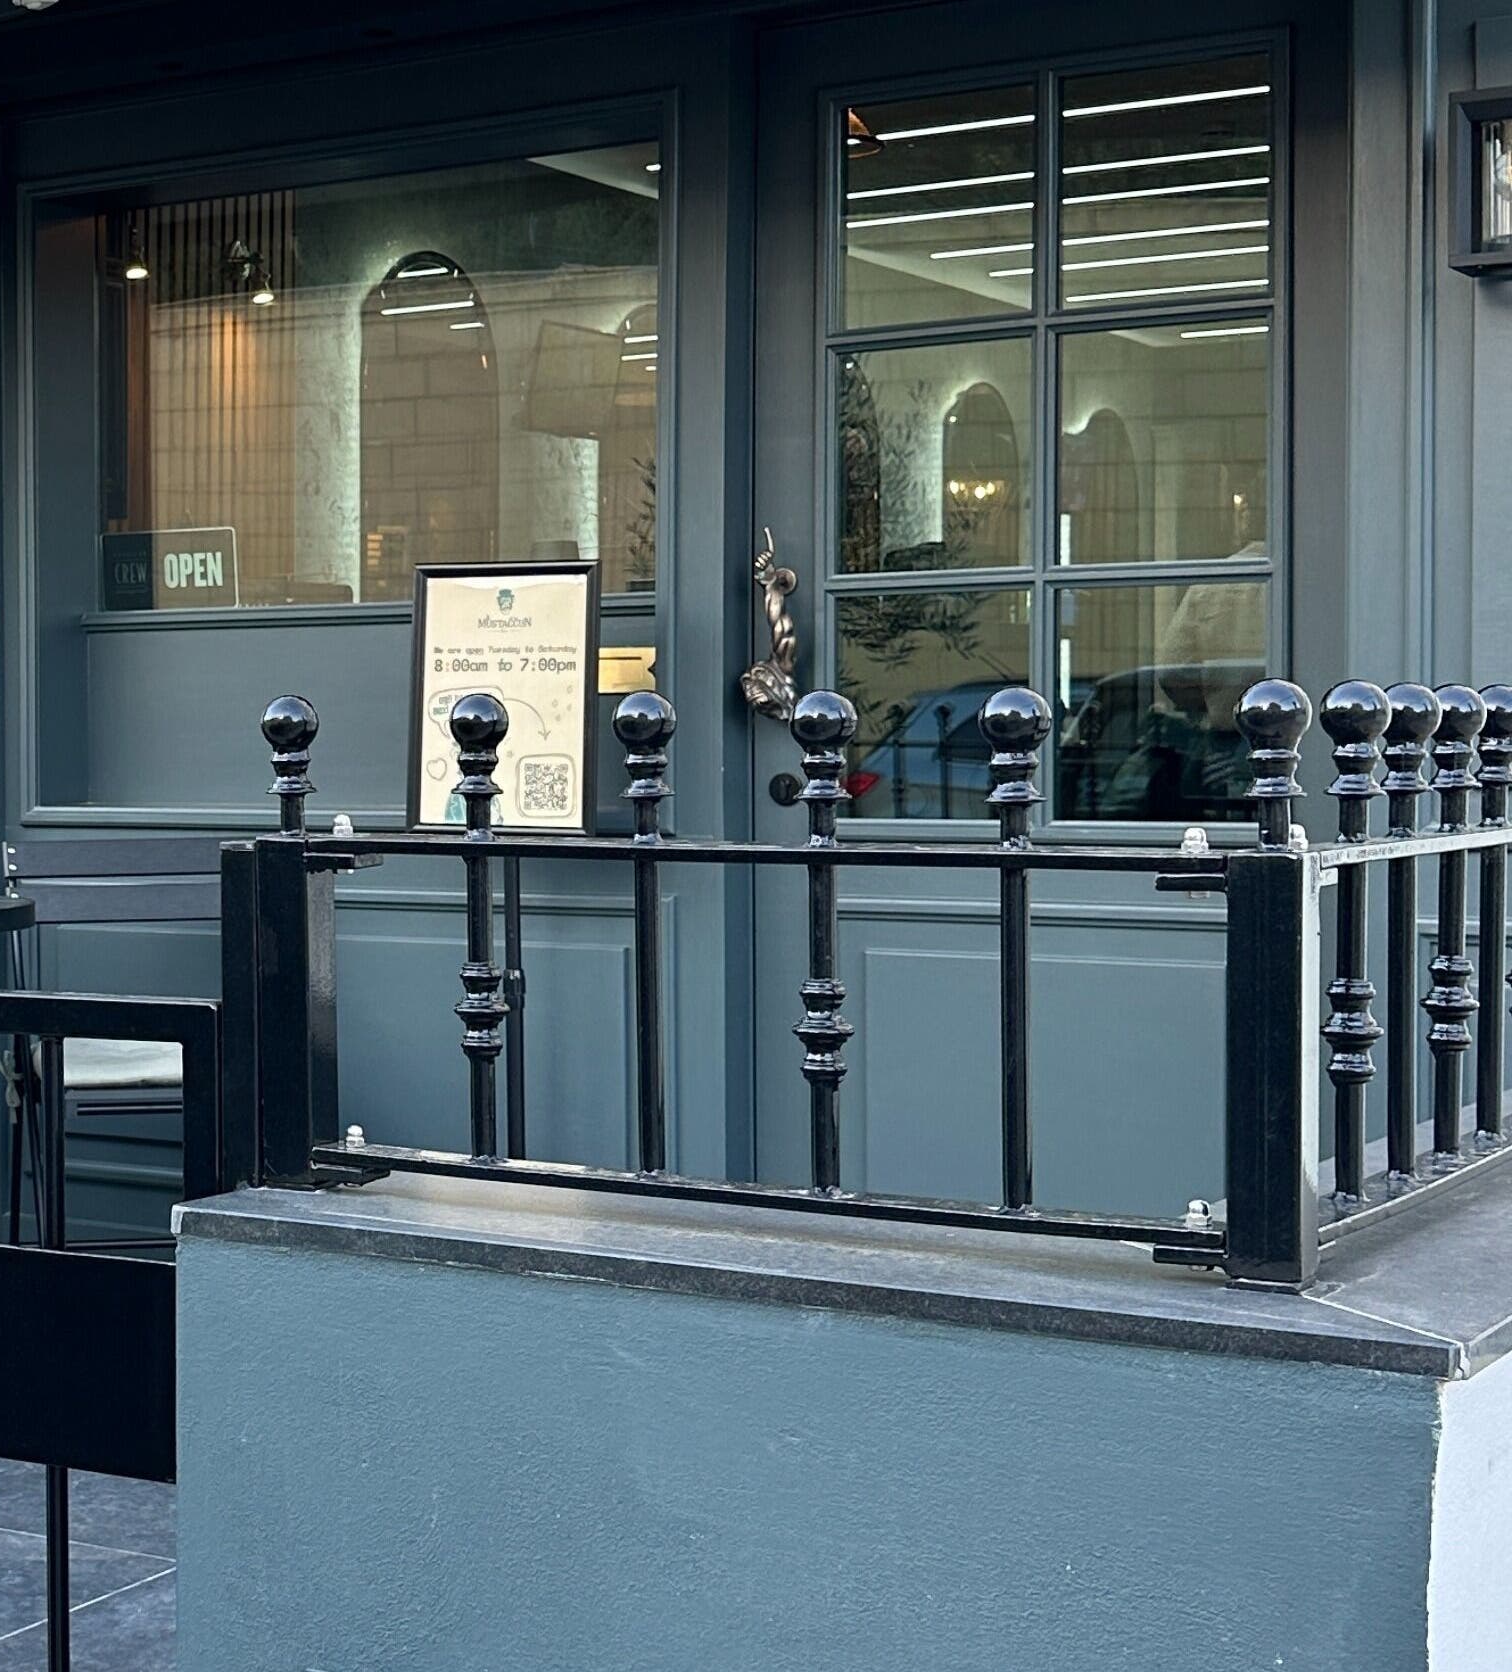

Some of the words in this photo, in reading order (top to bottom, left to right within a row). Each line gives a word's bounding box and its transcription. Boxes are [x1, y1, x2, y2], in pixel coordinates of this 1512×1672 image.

[115, 563, 147, 585] CREW
[163, 551, 223, 588] OPEN
[538, 645, 577, 654] Saturday
[434, 659, 488, 672] 8:00am
[498, 659, 512, 671] to
[520, 658, 576, 674] 7:00pm
